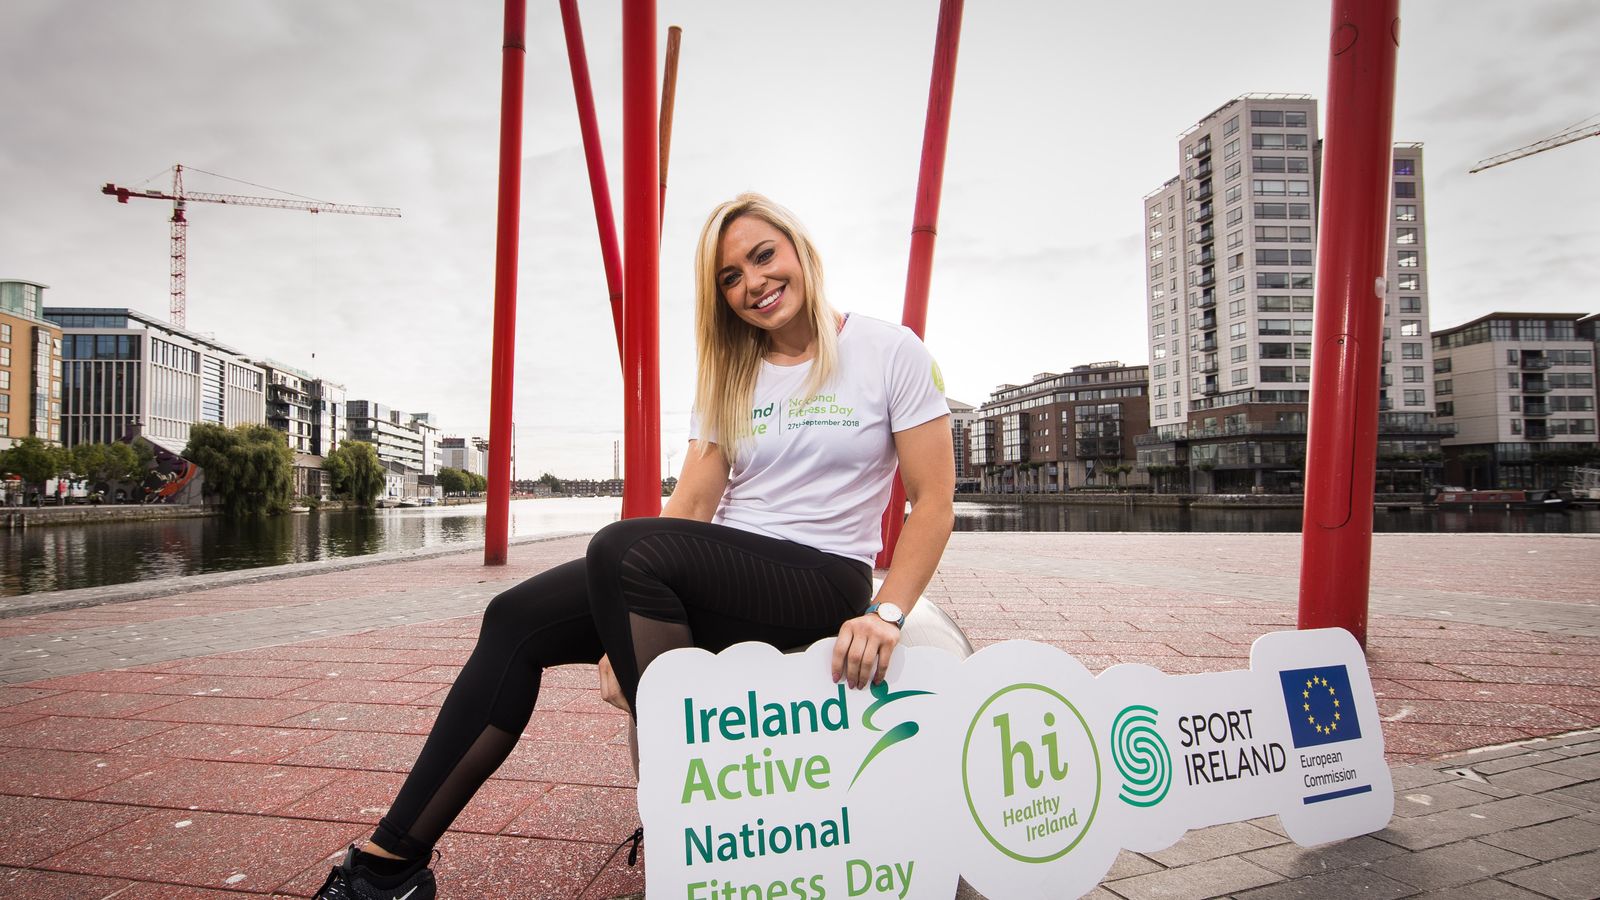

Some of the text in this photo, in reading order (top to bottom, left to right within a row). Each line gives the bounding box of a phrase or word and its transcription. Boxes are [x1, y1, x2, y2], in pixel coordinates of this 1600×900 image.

[829, 404, 854, 416] Day
[842, 419, 860, 427] 2018
[684, 684, 849, 744] Ireland
[1178, 708, 1253, 747] SPORT
[993, 712, 1068, 798] hi
[1185, 742, 1286, 786] IRELAND
[1300, 751, 1343, 769] European
[681, 747, 831, 804] Active
[1303, 768, 1357, 788] Commission
[1003, 796, 1060, 827] Healthy
[1026, 808, 1078, 842] Ireland
[684, 806, 851, 866] National
[845, 859, 915, 900] Day
